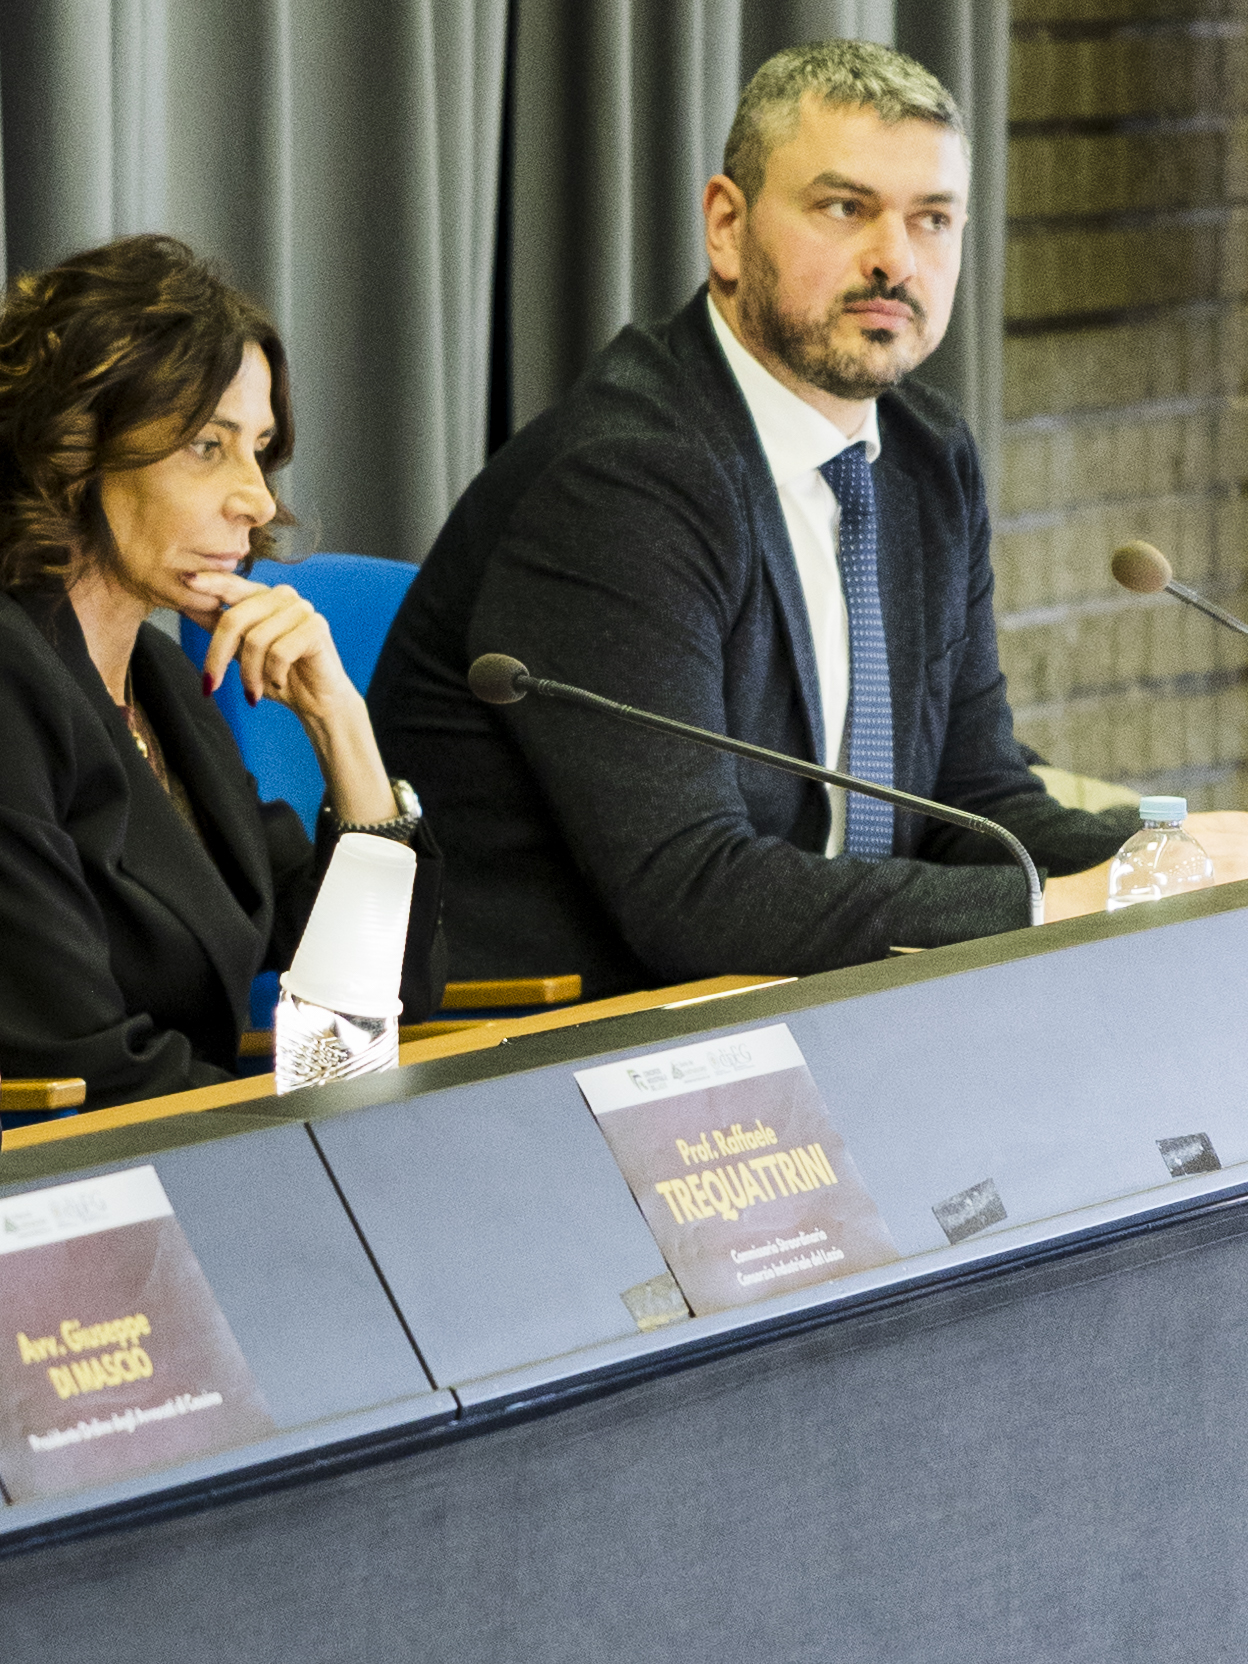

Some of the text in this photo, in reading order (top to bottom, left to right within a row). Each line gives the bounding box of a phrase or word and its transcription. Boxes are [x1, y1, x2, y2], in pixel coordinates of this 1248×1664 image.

[676, 1119, 778, 1165] Prof. Raffaele
[655, 1143, 836, 1224] TREQUATTRINI
[59, 1313, 151, 1353] Giuseppe
